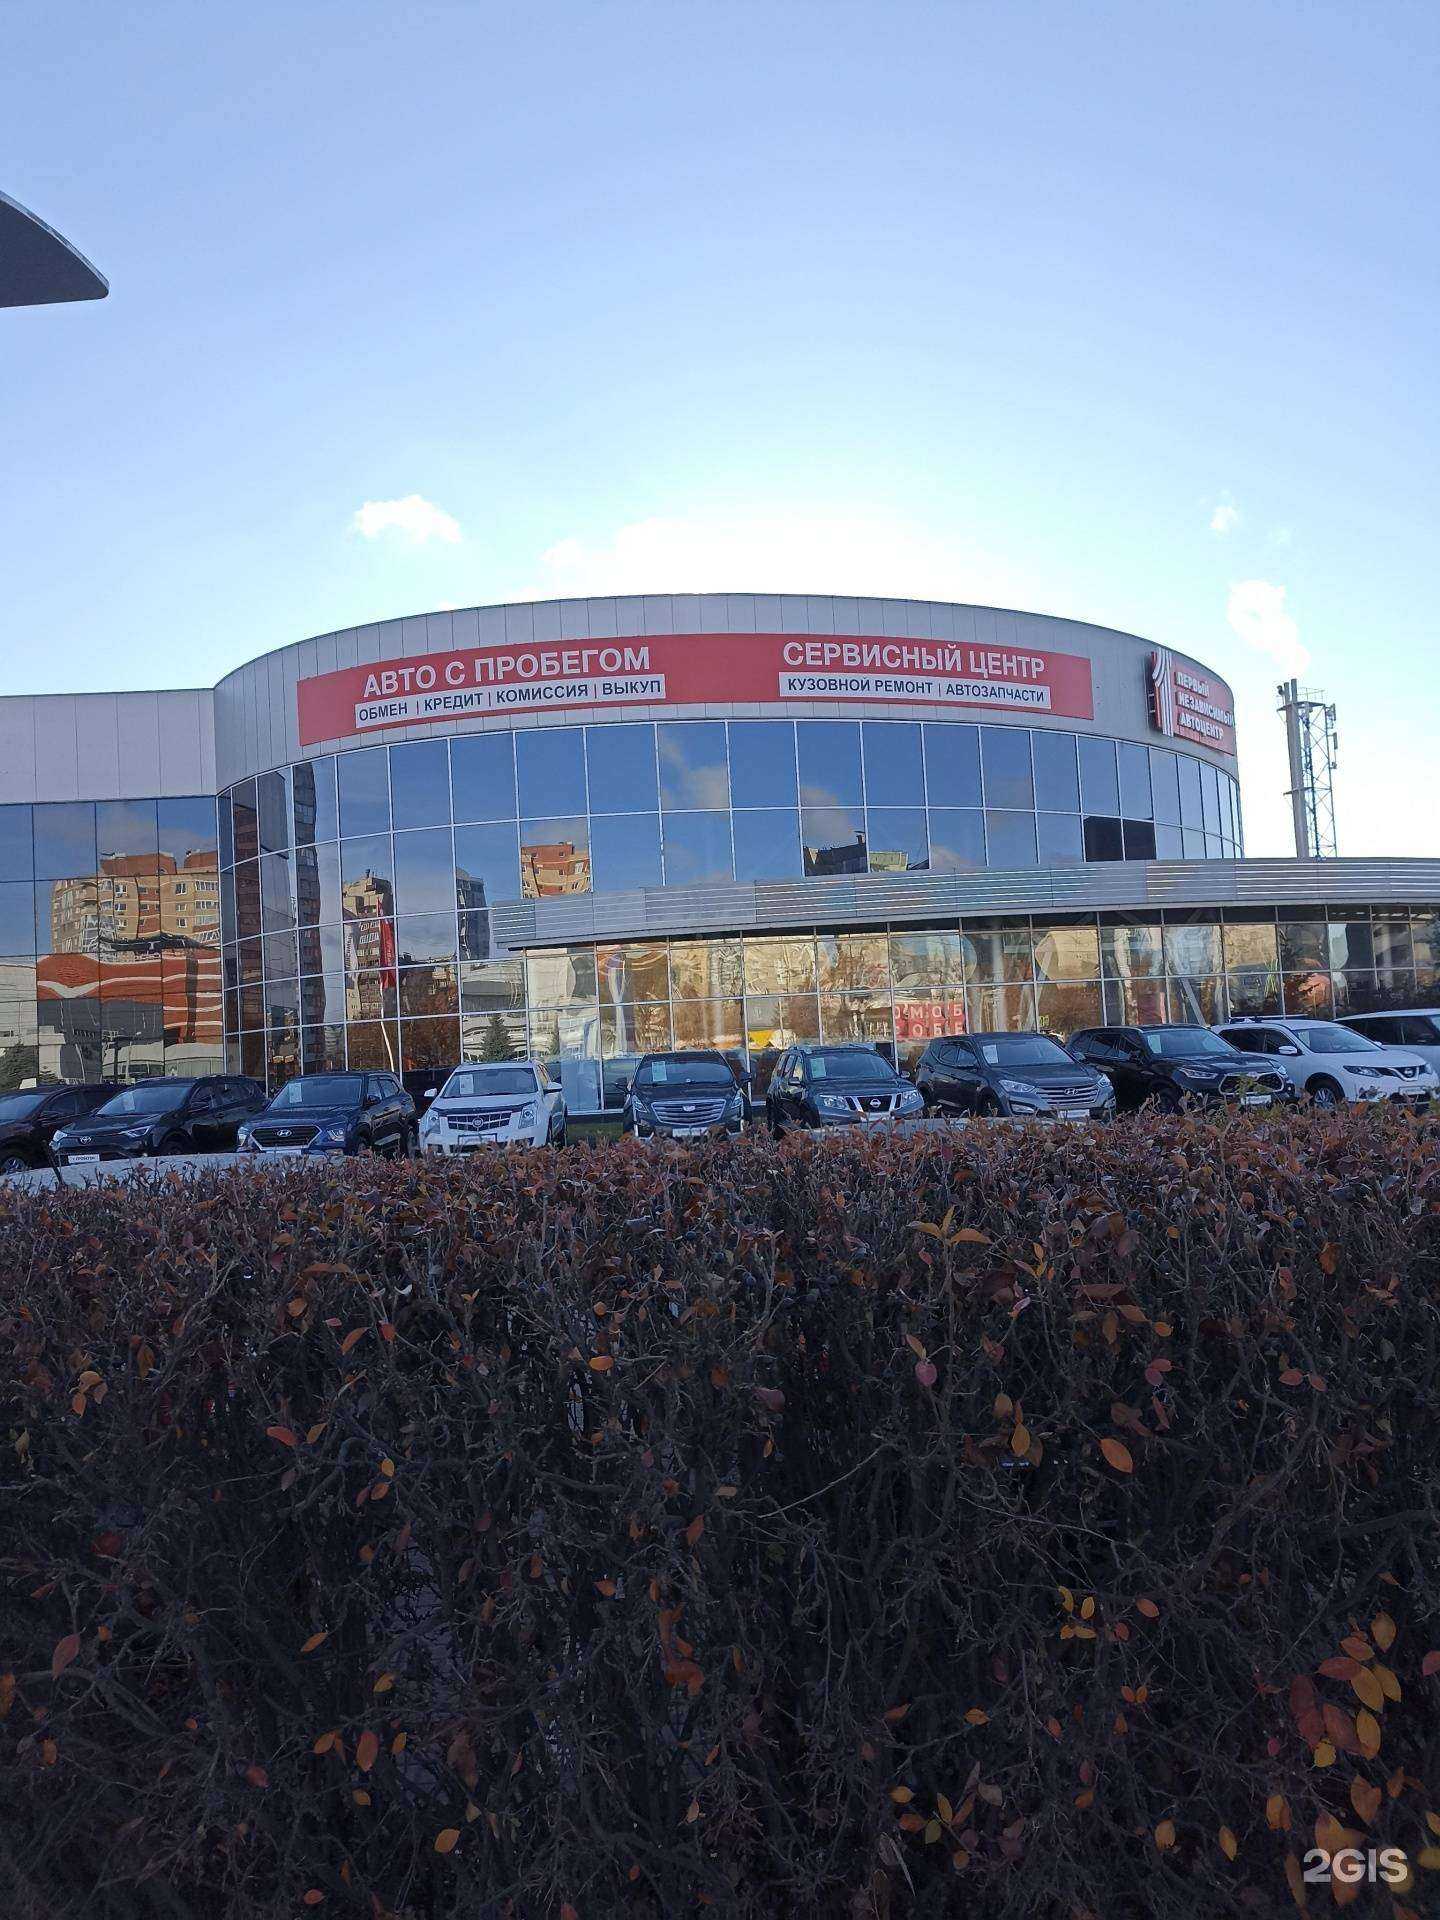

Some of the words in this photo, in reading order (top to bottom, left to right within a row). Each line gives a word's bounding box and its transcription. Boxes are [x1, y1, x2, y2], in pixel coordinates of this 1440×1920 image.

[363, 664, 437, 698] АВТО
[445, 660, 466, 685] С
[474, 646, 650, 682] ПРОБЕГОМ
[783, 641, 962, 672] СЕРВИСНЫЙ
[969, 650, 1045, 679] ЦЕНТР
[359, 702, 408, 722] ОБМЕН
[424, 692, 483, 711] КРЕДИТ
[496, 684, 588, 703] КОМИССИЯ
[602, 680, 661, 695] ВЫКУП
[788, 677, 870, 692] КУЗОВНОЙ
[875, 680, 933, 694] РЕМОНТ
[946, 683, 1044, 702] АВТОЗАПЧАСТИ
[1179, 713, 1224, 740] АВТОЦЕНТР
